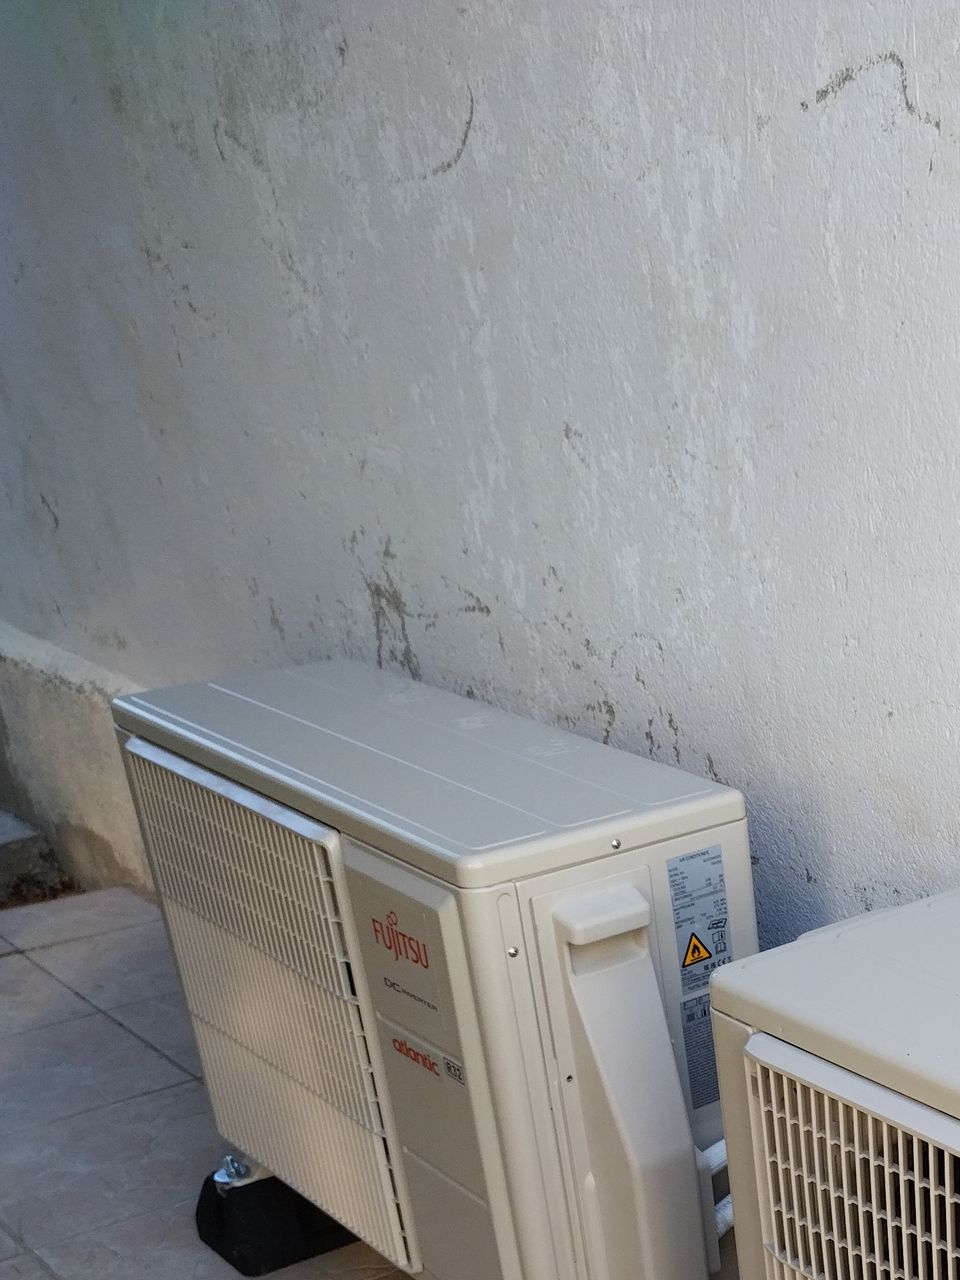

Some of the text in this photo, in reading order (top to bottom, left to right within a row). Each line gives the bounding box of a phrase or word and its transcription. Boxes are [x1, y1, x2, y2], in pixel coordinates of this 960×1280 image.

[371, 915, 430, 970] FUJITSU
[383, 976, 438, 1013] DC INVERTER
[392, 1037, 464, 1082] atlantic R32
